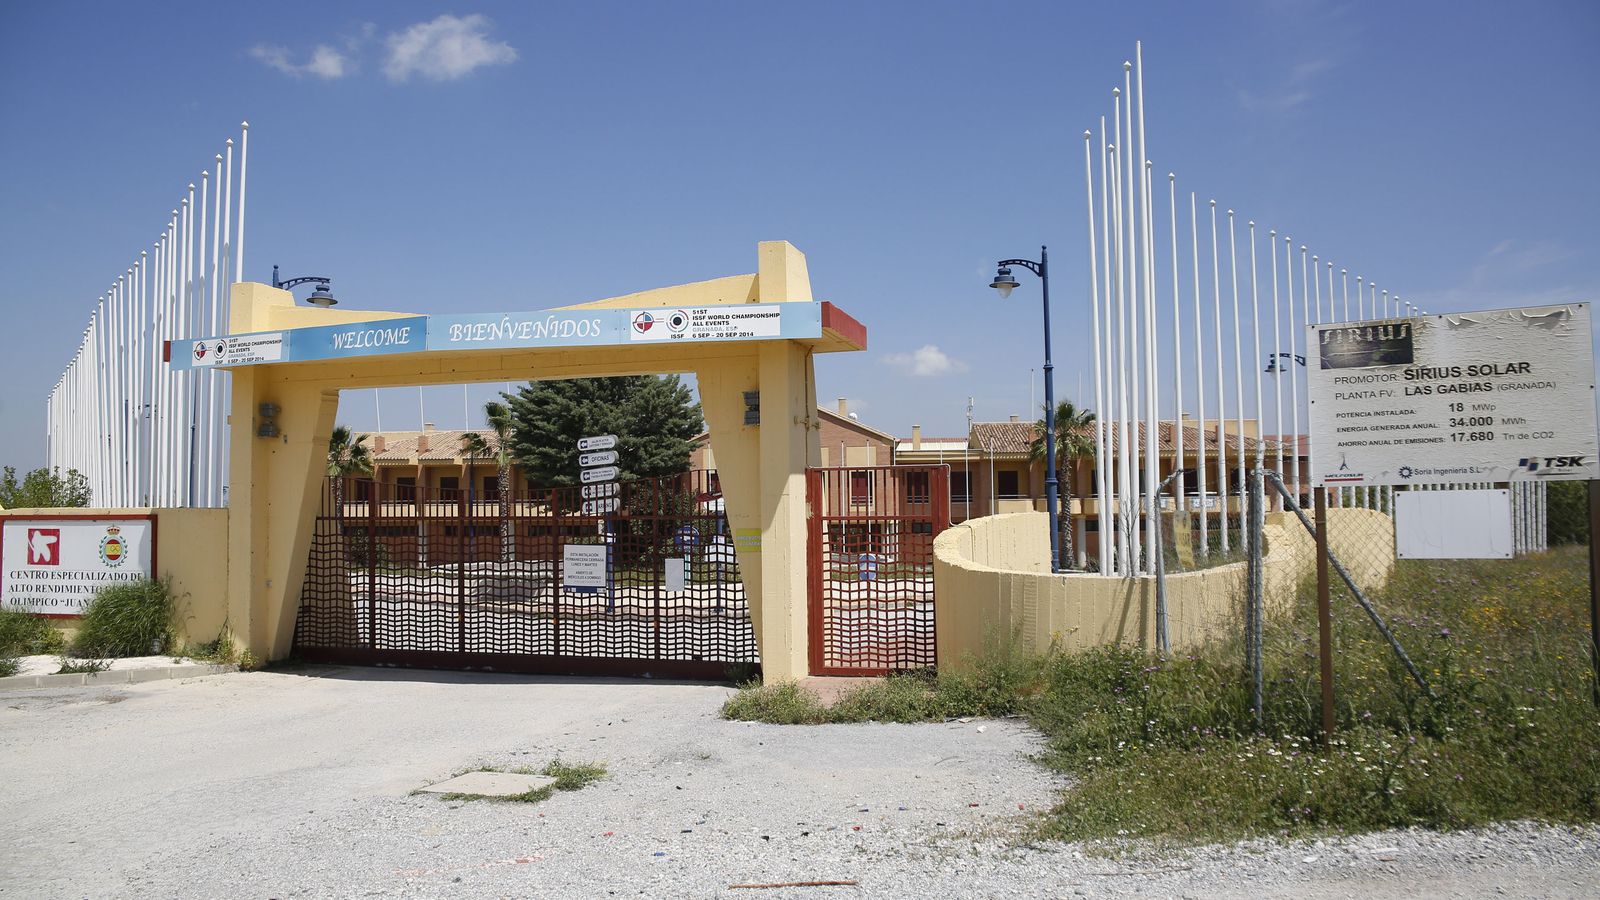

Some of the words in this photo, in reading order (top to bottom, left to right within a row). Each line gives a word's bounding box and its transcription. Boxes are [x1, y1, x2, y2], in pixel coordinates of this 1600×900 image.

[449, 314, 602, 343] BIENVENIDOS
[332, 326, 411, 351] WELCOME
[1334, 374, 1399, 385] PROMOTOR:
[1404, 366, 1461, 380] SIRIUS
[1467, 362, 1530, 376] SOLAR
[1335, 389, 1377, 400] PLANTA
[1380, 389, 1396, 399] FV:
[1405, 385, 1432, 396] LAS
[1437, 382, 1493, 394] GABIAS
[1497, 381, 1556, 392] (GRANADA)
[1449, 403, 1464, 412] 18
[1472, 404, 1496, 412] MWp
[1449, 417, 1493, 427] 34.000
[1450, 431, 1494, 442] 17.680
[1532, 431, 1555, 439] CO2
[1544, 456, 1585, 467] TSK
[10, 570, 48, 580] CENTRO
[51, 571, 128, 581] ESPECIALIZADO
[9, 584, 33, 593] ALTO
[35, 584, 102, 594] RENDIMIENTO
